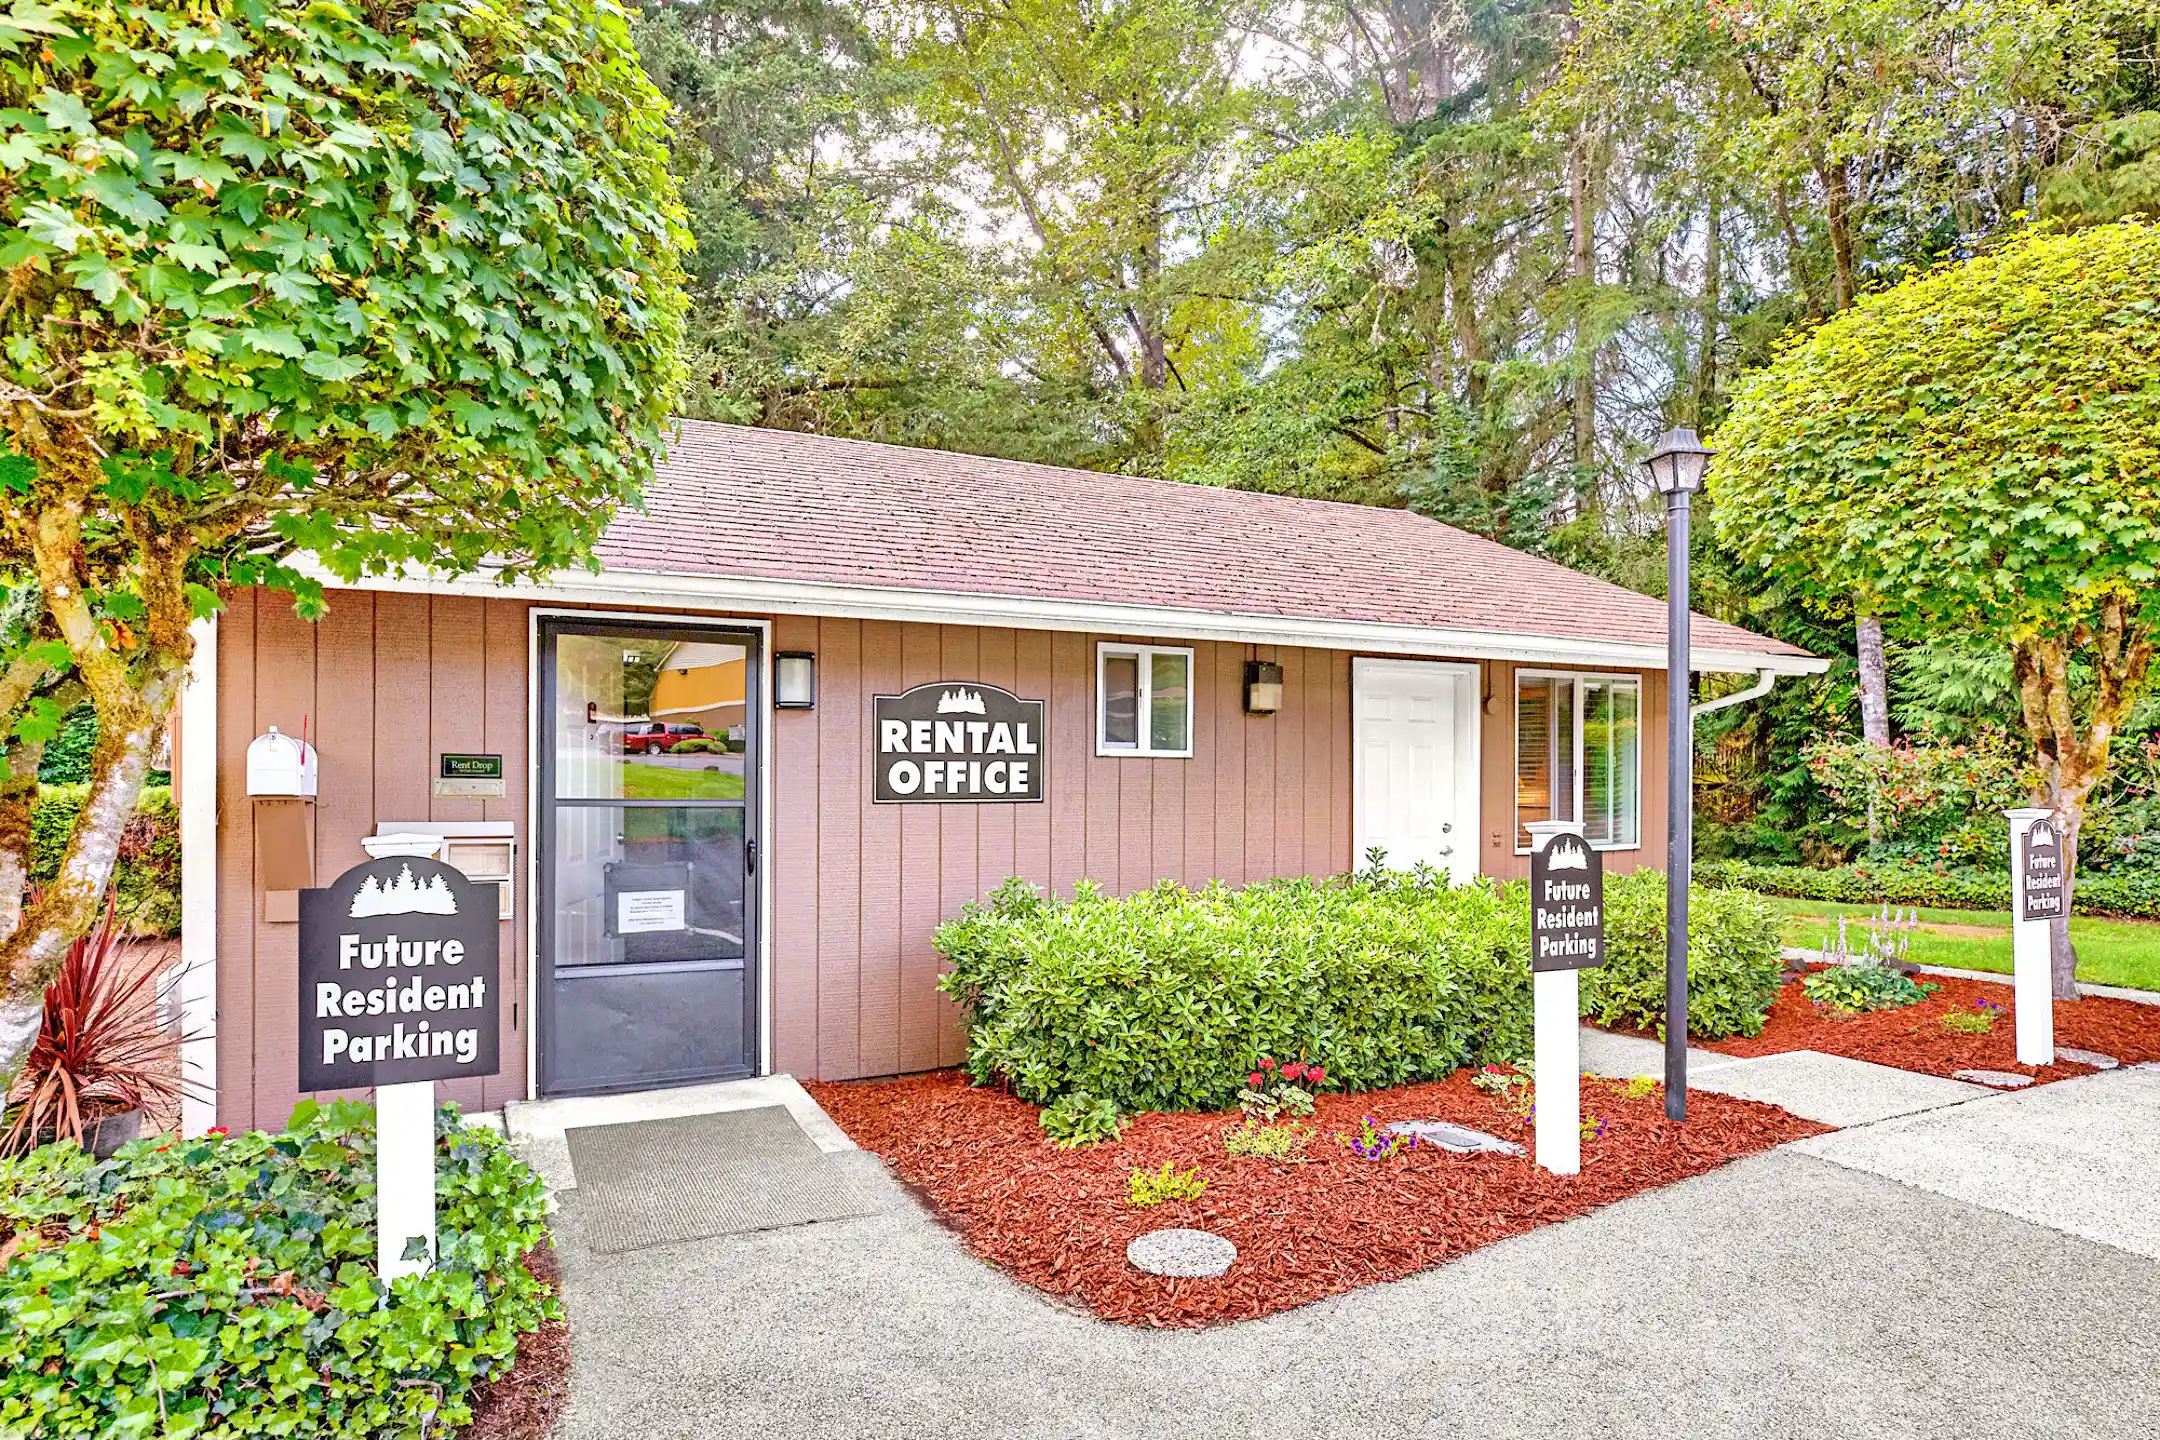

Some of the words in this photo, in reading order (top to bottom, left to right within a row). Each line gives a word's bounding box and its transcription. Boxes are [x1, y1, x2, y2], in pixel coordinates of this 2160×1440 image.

[880, 719, 1038, 755] RENTAL
[451, 760, 471, 769] Rent
[472, 760, 493, 772] Drop
[888, 759, 1029, 795] OFFICE
[2029, 853, 2057, 870] Future
[1544, 879, 1591, 902] Future
[2025, 872, 2061, 891] Resident
[2027, 892, 2060, 912] Parking
[1537, 904, 1599, 930] Resident
[339, 933, 465, 970] Future
[1539, 931, 1597, 959] Parking
[316, 975, 486, 1018] Resident
[322, 1020, 478, 1065] Parking
